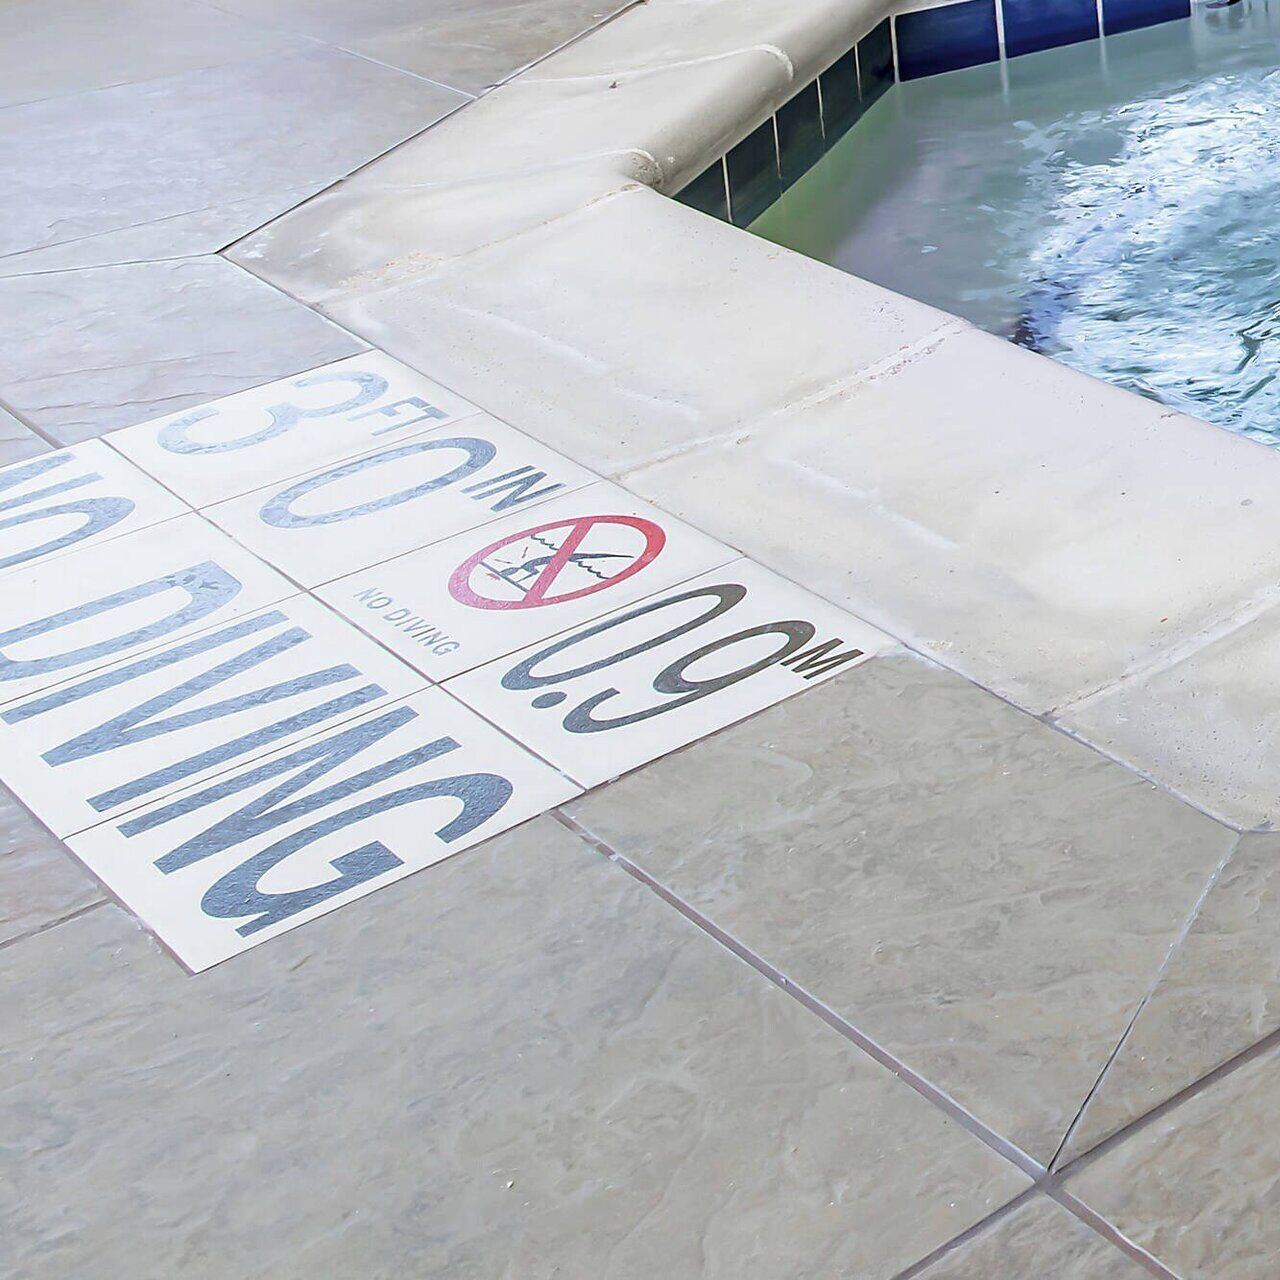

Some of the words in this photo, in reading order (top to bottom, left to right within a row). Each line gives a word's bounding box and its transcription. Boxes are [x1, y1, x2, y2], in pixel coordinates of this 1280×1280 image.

[157, 370, 389, 455] 3
[344, 394, 453, 438] FT
[460, 464, 567, 512] IN
[353, 587, 393, 609] NO
[382, 607, 460, 656] DIVING
[500, 582, 818, 734] 0.9
[780, 637, 864, 680] M
[0, 559, 514, 939] DIVING
